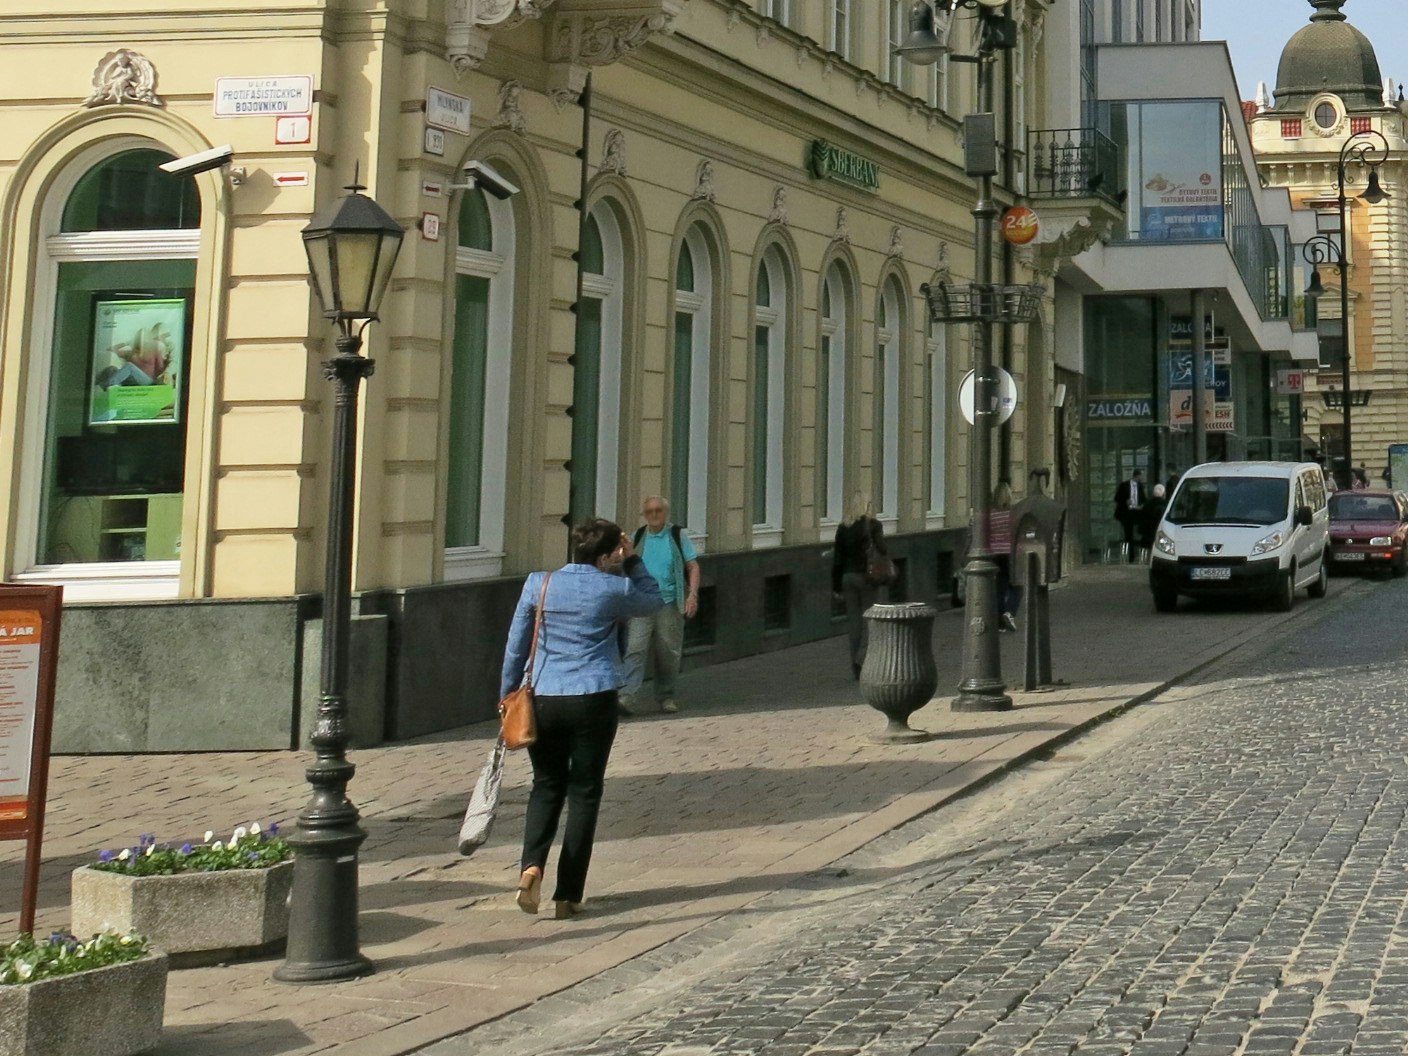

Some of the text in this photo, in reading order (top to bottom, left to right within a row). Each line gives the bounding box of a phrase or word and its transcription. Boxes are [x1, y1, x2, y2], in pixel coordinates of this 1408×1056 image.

[235, 100, 288, 112] BOJOVNÍKOV
[1006, 215, 1027, 228] 24
[1088, 398, 1151, 417] ZÁLOŽŇA
[10, 626, 34, 636] JAR
